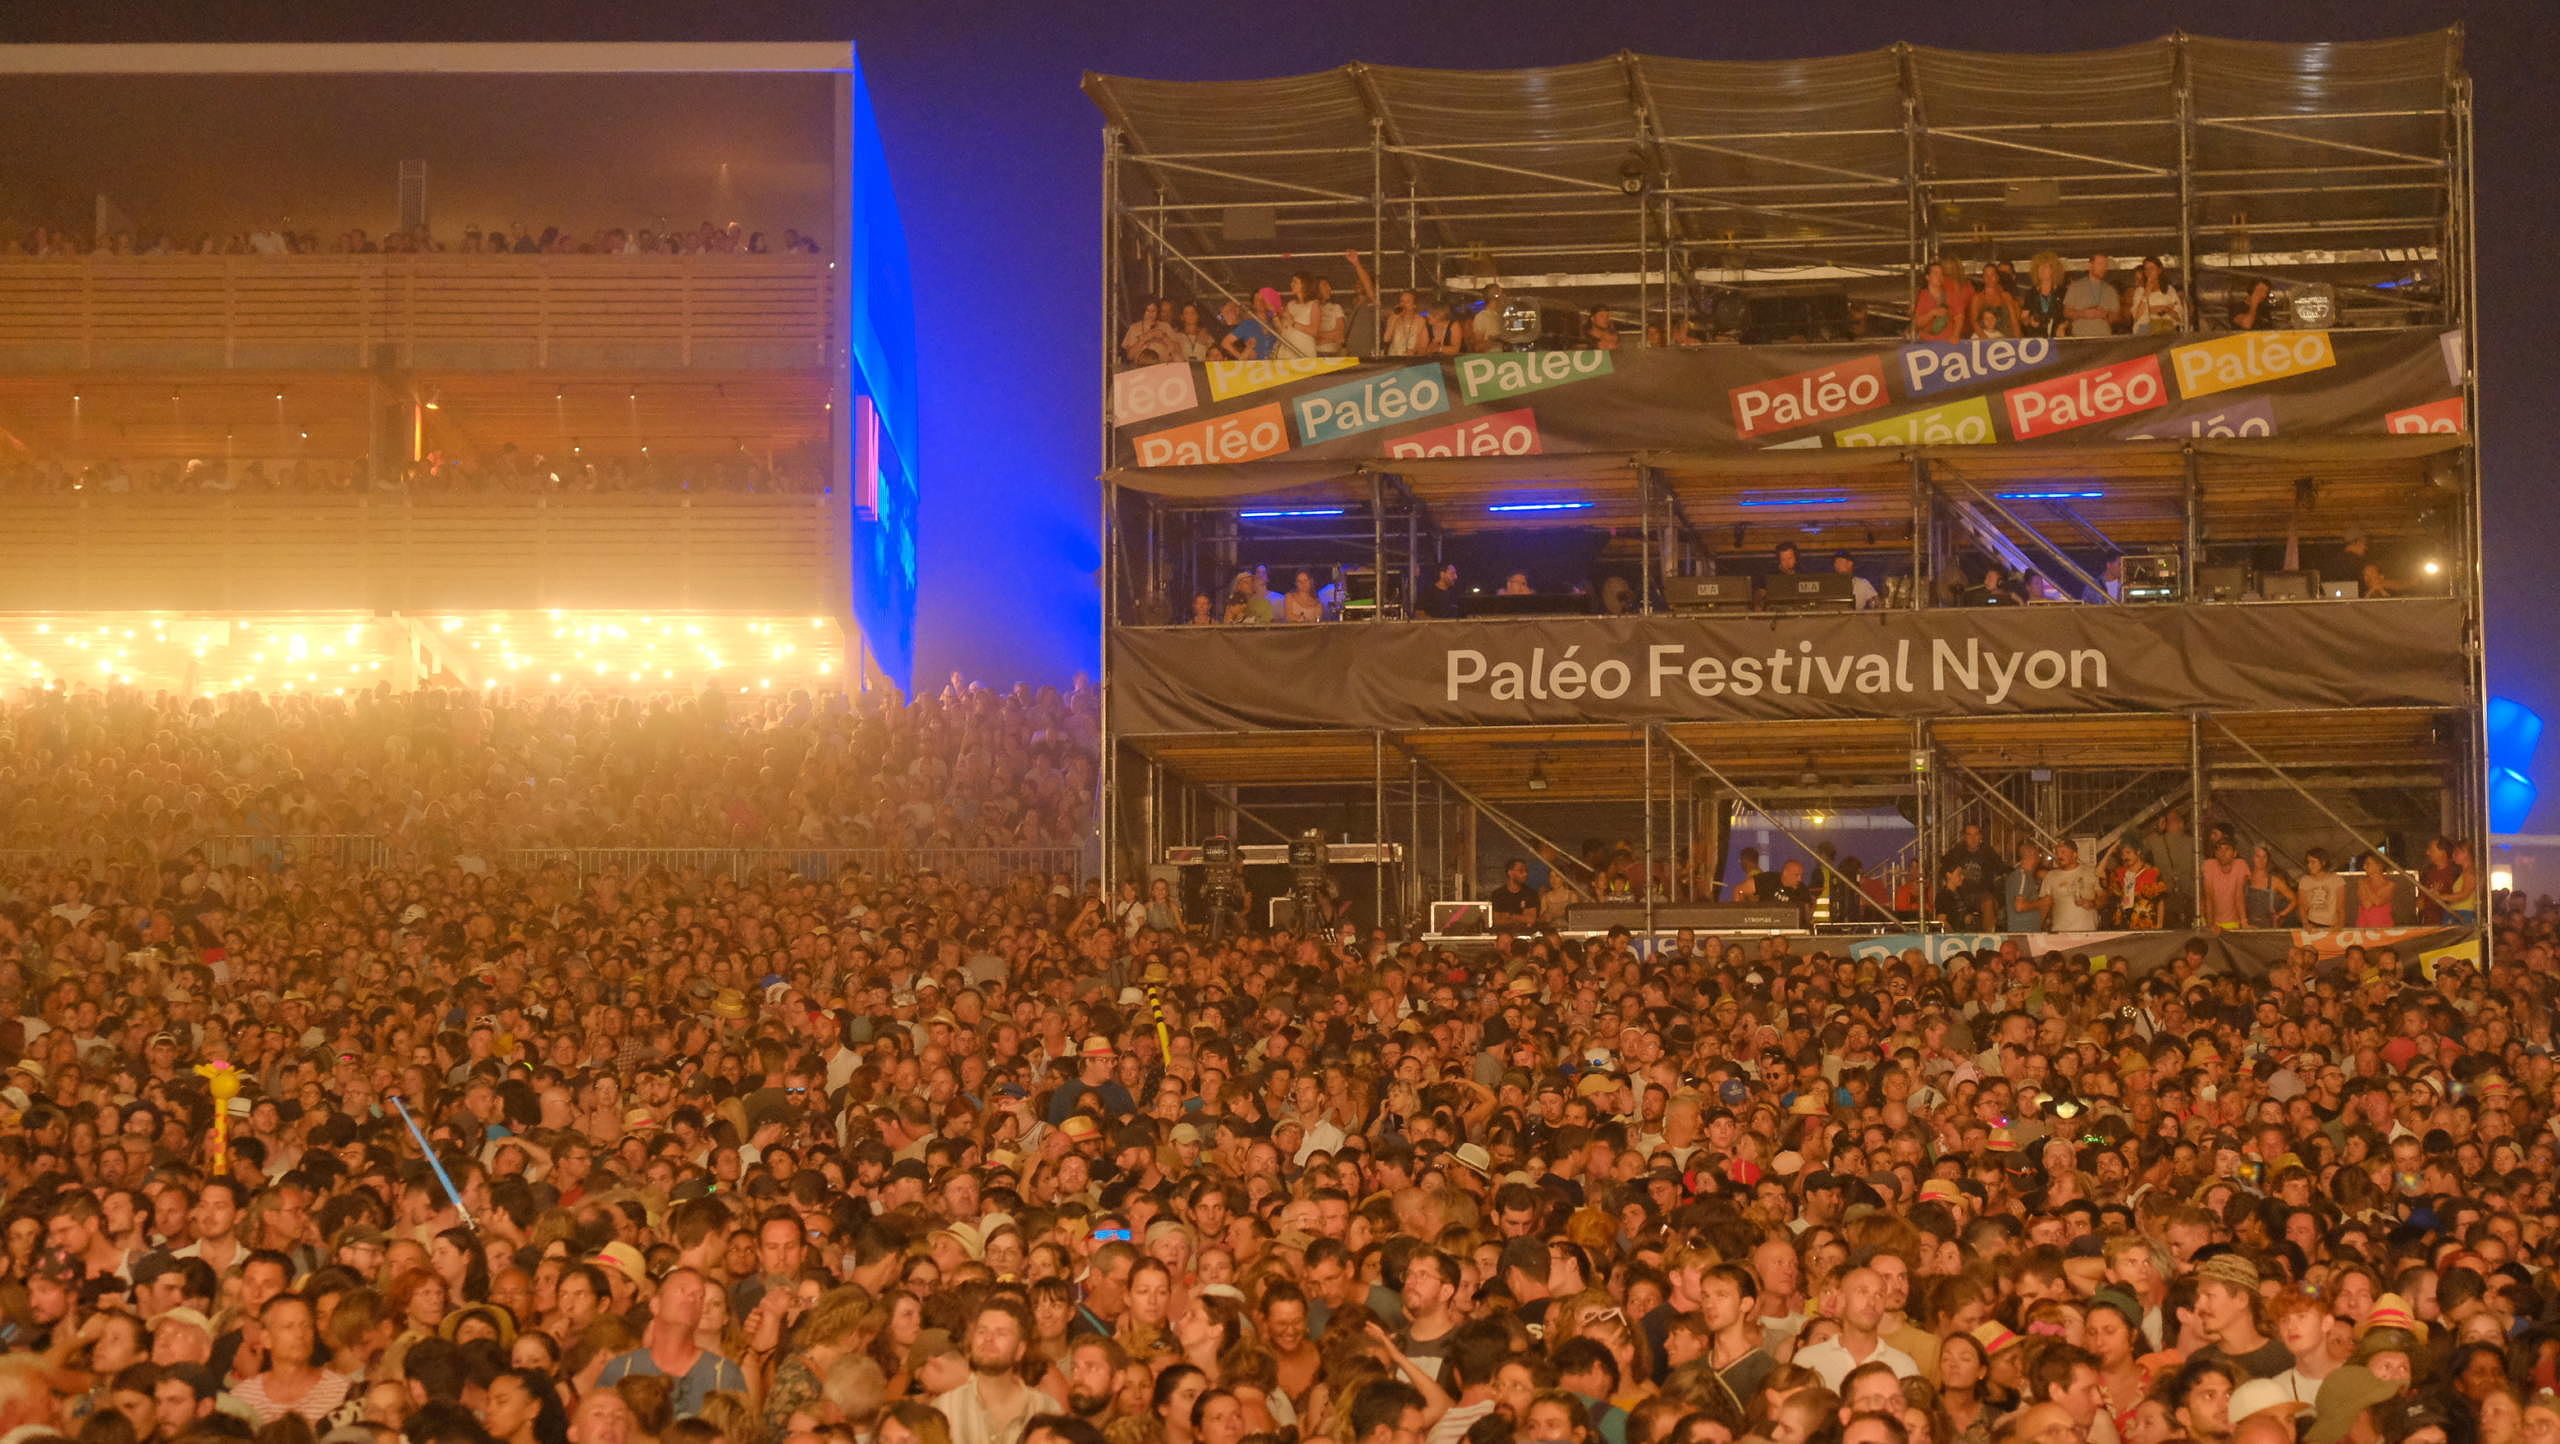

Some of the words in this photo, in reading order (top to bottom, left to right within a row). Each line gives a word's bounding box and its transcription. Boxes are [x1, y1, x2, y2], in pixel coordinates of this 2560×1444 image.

[2179, 331, 2327, 391] Paléo
[1114, 373, 1188, 419] léo
[1302, 377, 1441, 439] Paléo
[1737, 371, 1880, 431] Paléo
[2013, 371, 2157, 433] Paléo
[1142, 419, 1281, 467] Paléo
[1447, 644, 1632, 701] Paléo
[1649, 638, 1914, 698] Festival
[1932, 637, 2108, 705] Nyon
